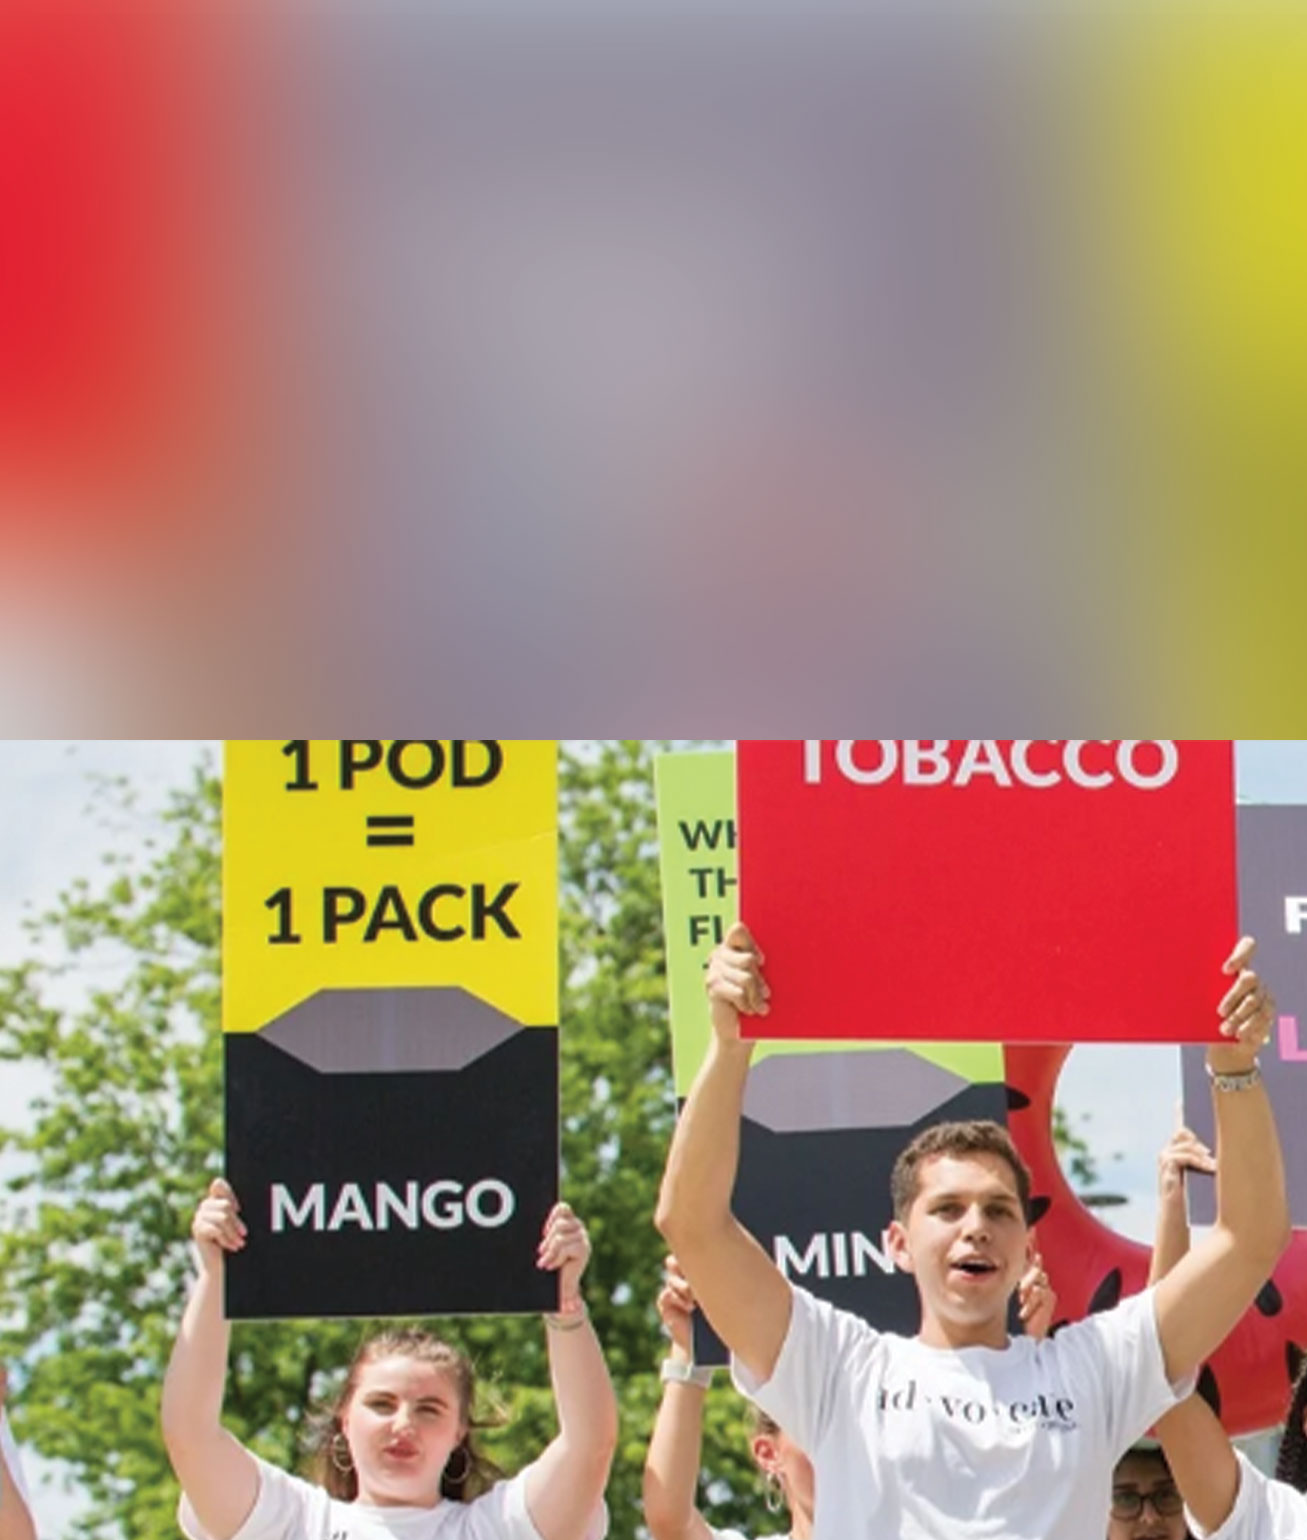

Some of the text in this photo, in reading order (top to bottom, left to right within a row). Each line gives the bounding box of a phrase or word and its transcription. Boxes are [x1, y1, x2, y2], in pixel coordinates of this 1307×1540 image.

[282, 741, 503, 791] 1 POD
[804, 741, 1179, 789] TOBACCO
[264, 883, 520, 944] 1 PACK
[270, 1179, 515, 1232] MANGO
[774, 1230, 896, 1278] MIN
